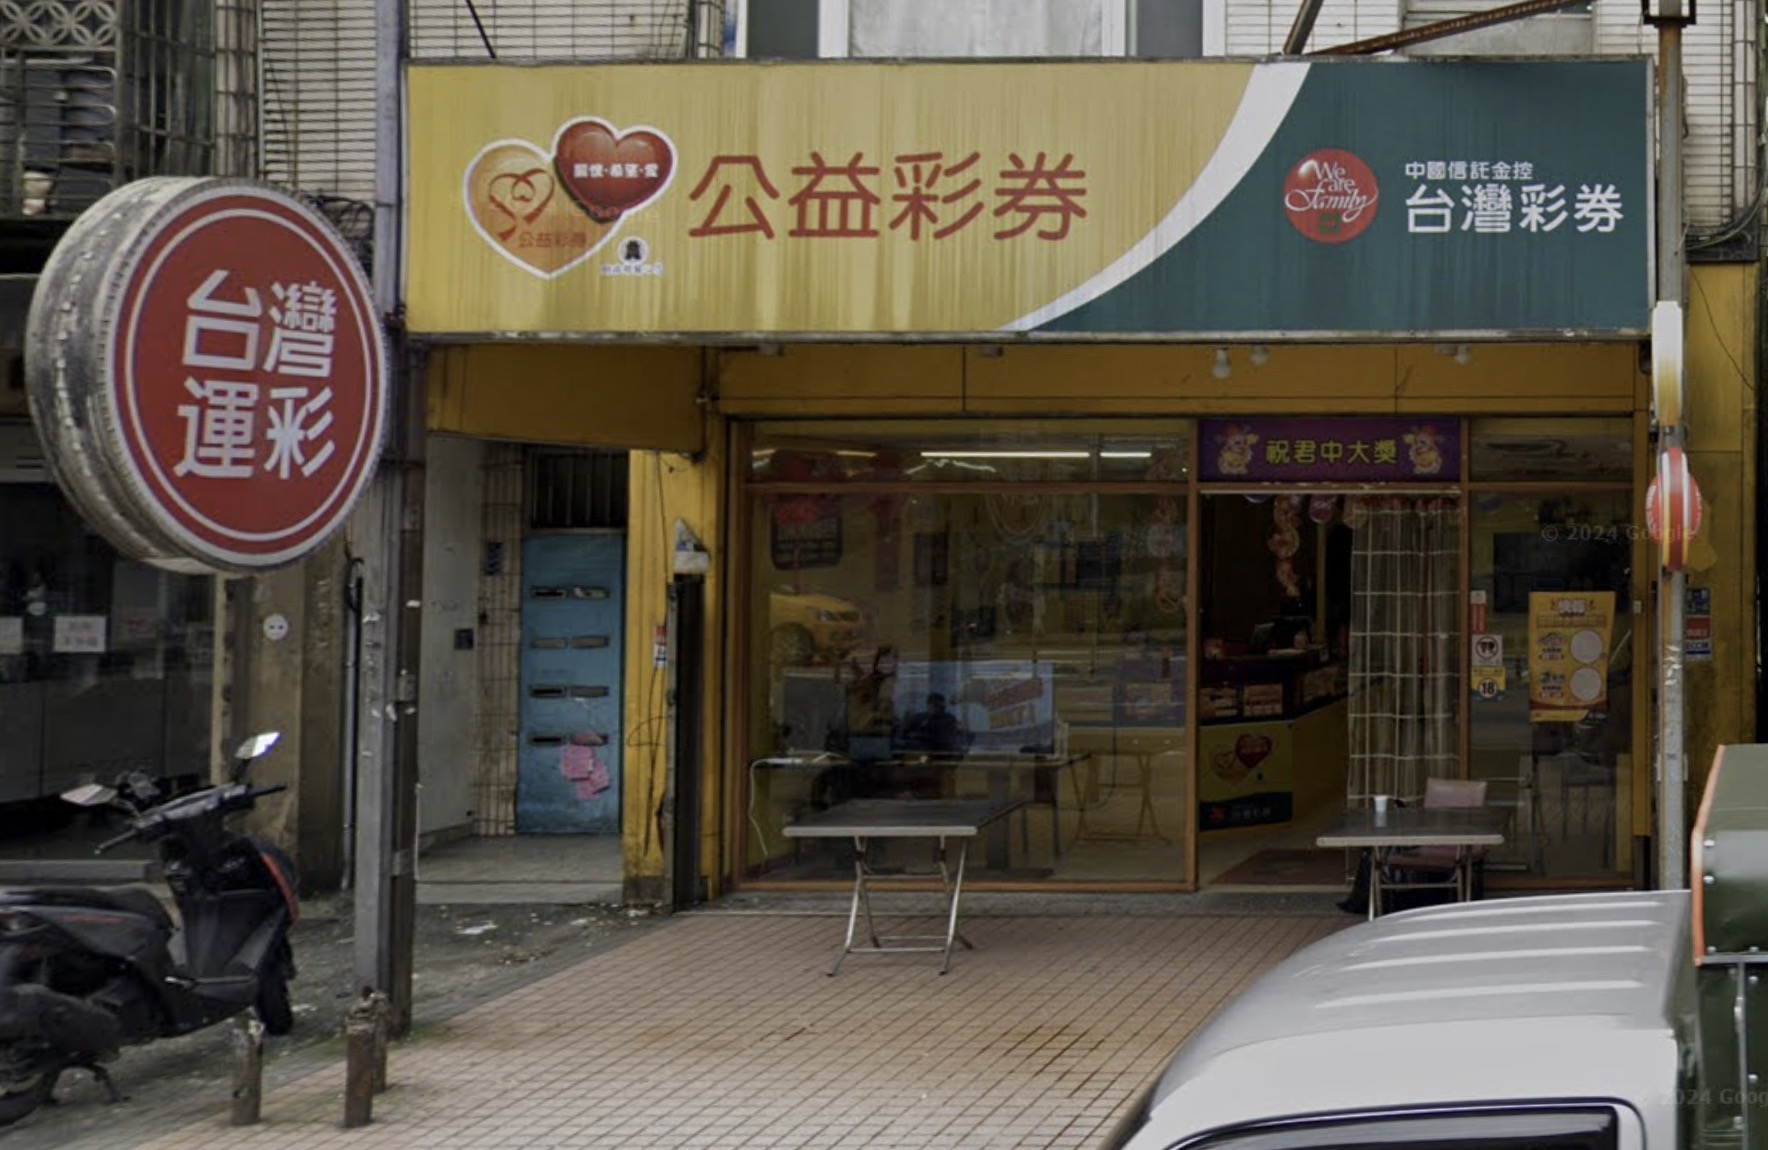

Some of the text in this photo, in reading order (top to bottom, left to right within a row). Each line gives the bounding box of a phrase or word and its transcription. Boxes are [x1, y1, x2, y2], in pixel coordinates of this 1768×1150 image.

[1299, 159, 1346, 180] We
[1404, 161, 1533, 180] 中國信託金控
[689, 151, 1087, 241] 公益彩券
[1405, 183, 1624, 233] 台灣彩券
[182, 269, 337, 378] 台灣
[173, 376, 336, 480] 運彩
[1265, 440, 1397, 464] 祝君中大獎
[1481, 681, 1495, 694] 18
